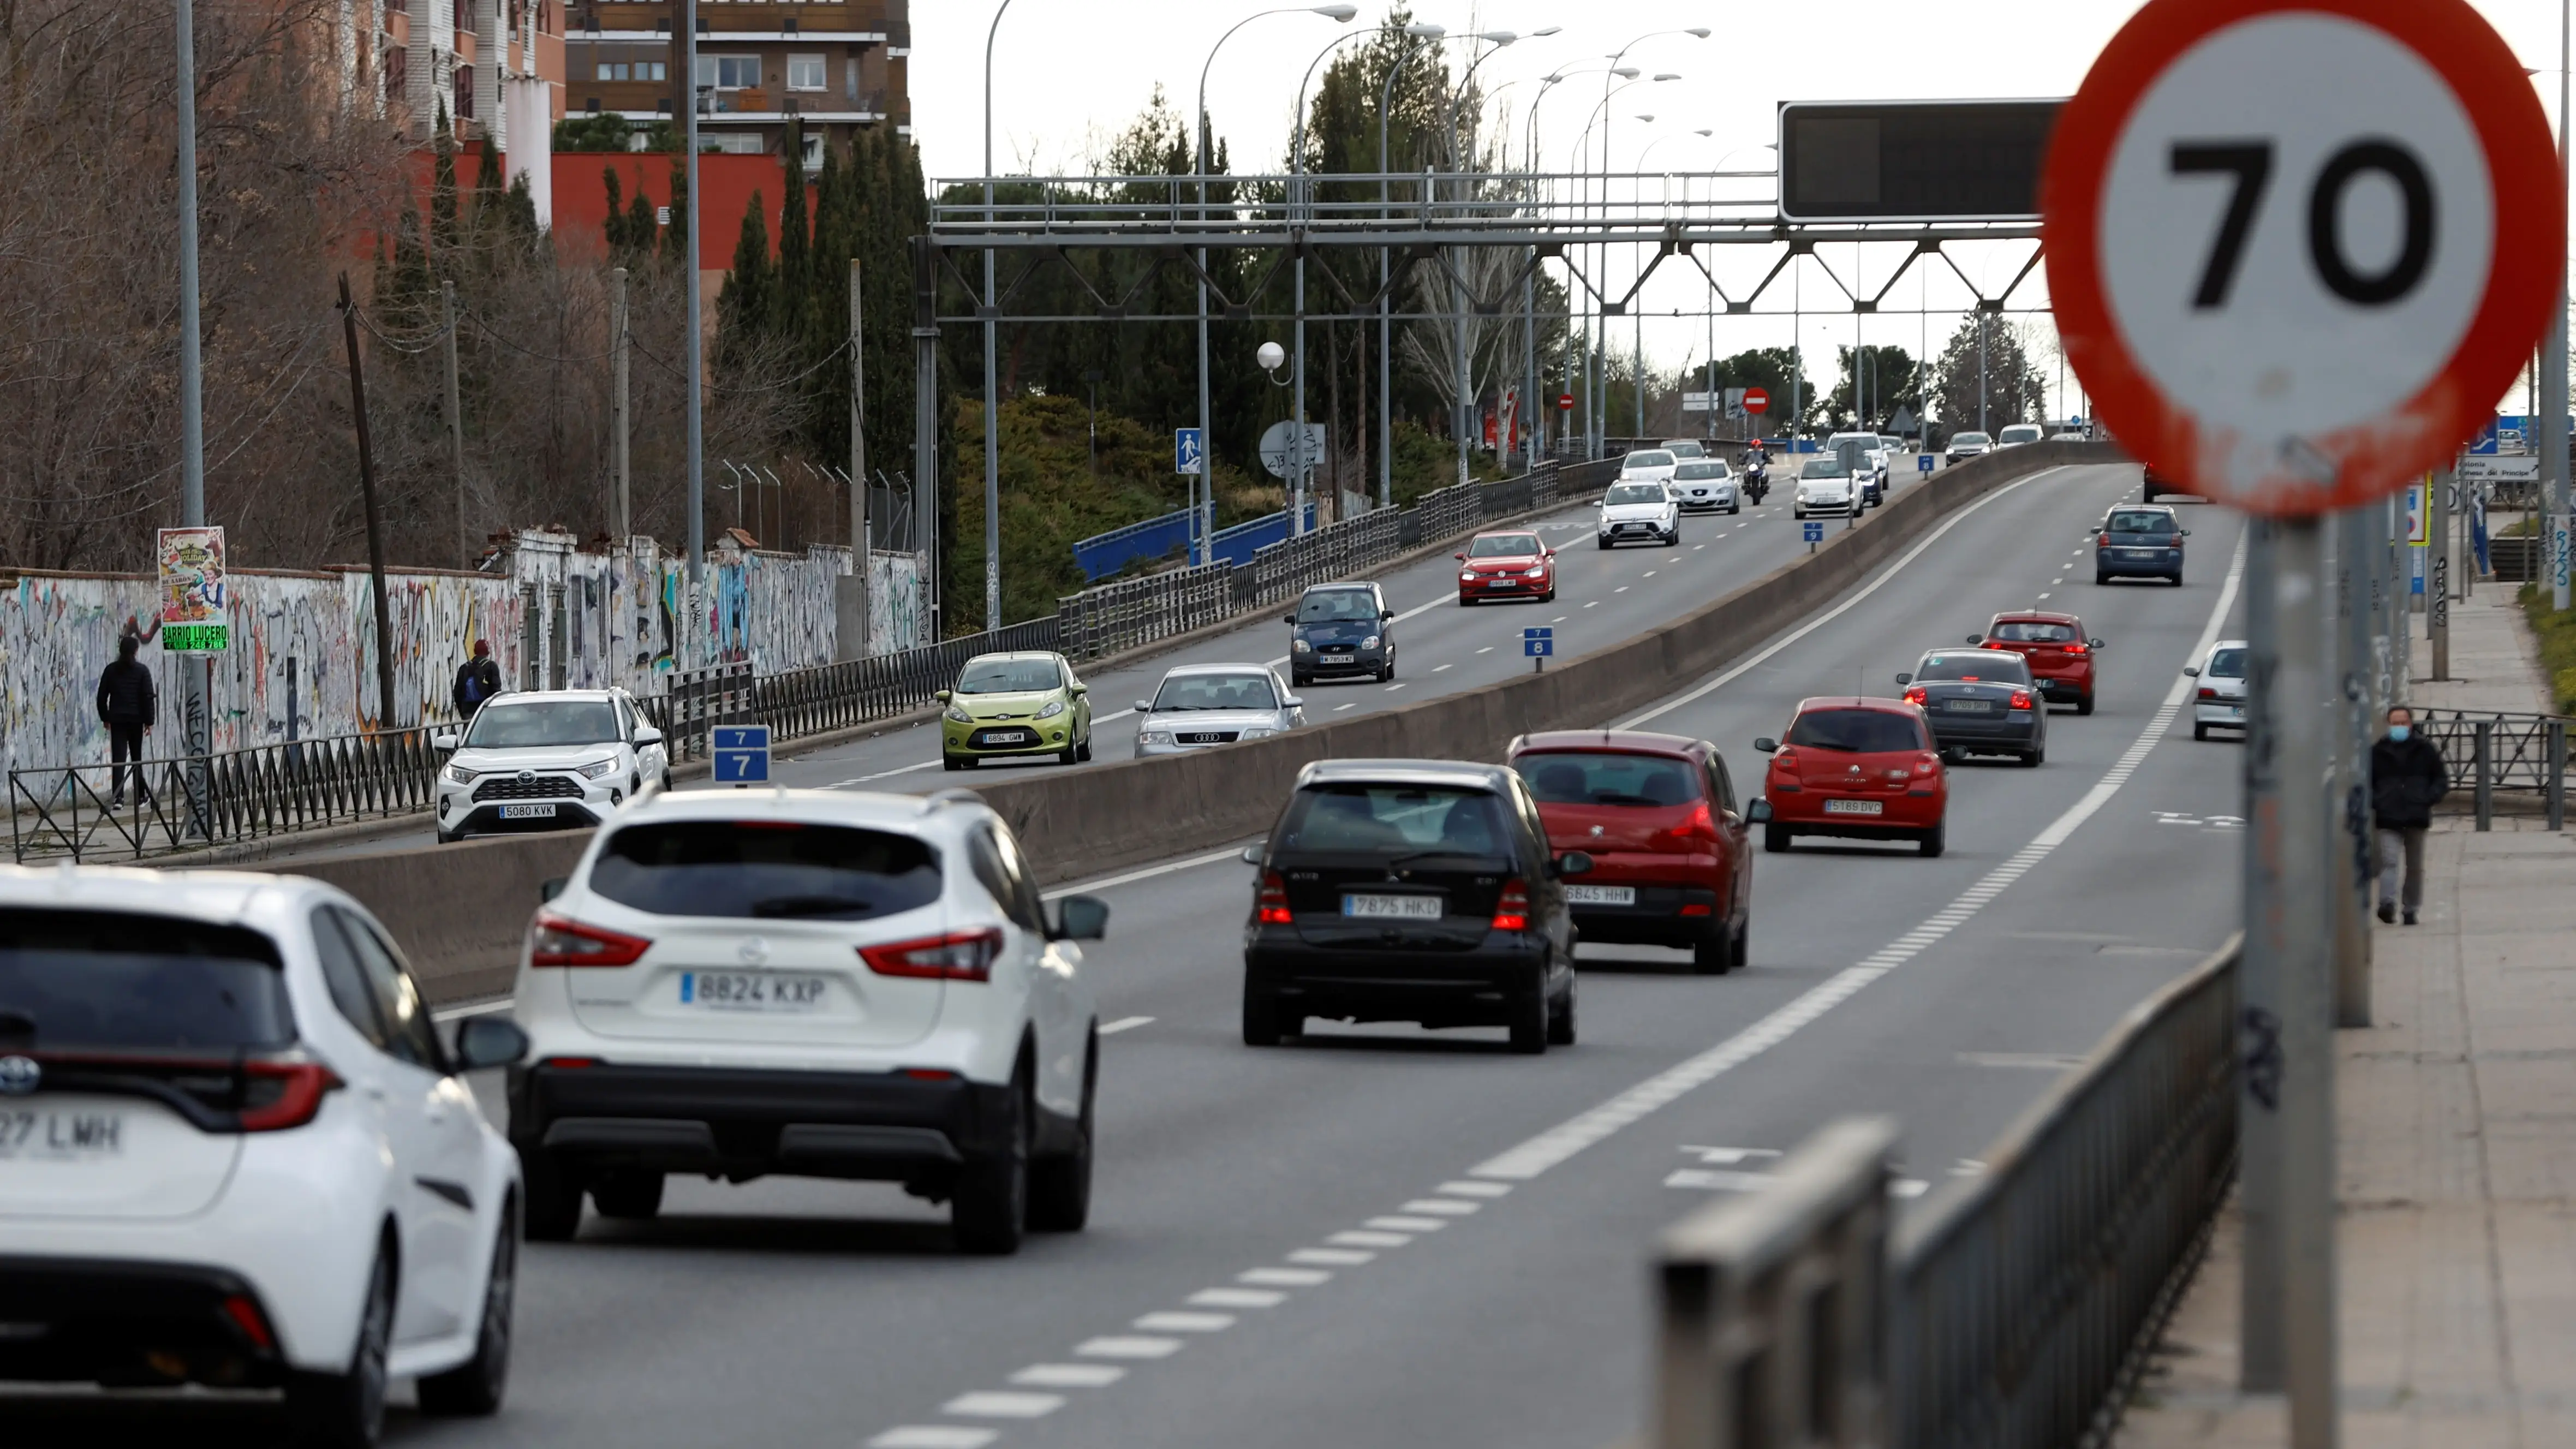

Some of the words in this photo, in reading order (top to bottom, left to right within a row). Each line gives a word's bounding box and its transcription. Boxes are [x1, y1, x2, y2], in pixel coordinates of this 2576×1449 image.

[2168, 136, 2438, 310] 70
[1810, 532, 1817, 540] 9
[163, 626, 191, 641] BARRIO
[194, 625, 226, 640] LUCERO
[190, 641, 205, 649] 248
[208, 641, 224, 649] 786
[1534, 642, 1543, 654] 8
[735, 732, 746, 745] 7
[732, 755, 750, 777] 7
[506, 806, 531, 816] 5080
[534, 805, 552, 815] KVK
[1833, 801, 1858, 811] 5189
[1861, 802, 1881, 813] DVC
[1358, 897, 1399, 914] 7875
[1406, 898, 1437, 915] HKD
[699, 974, 764, 1003] 8824
[773, 977, 825, 1005] KXP
